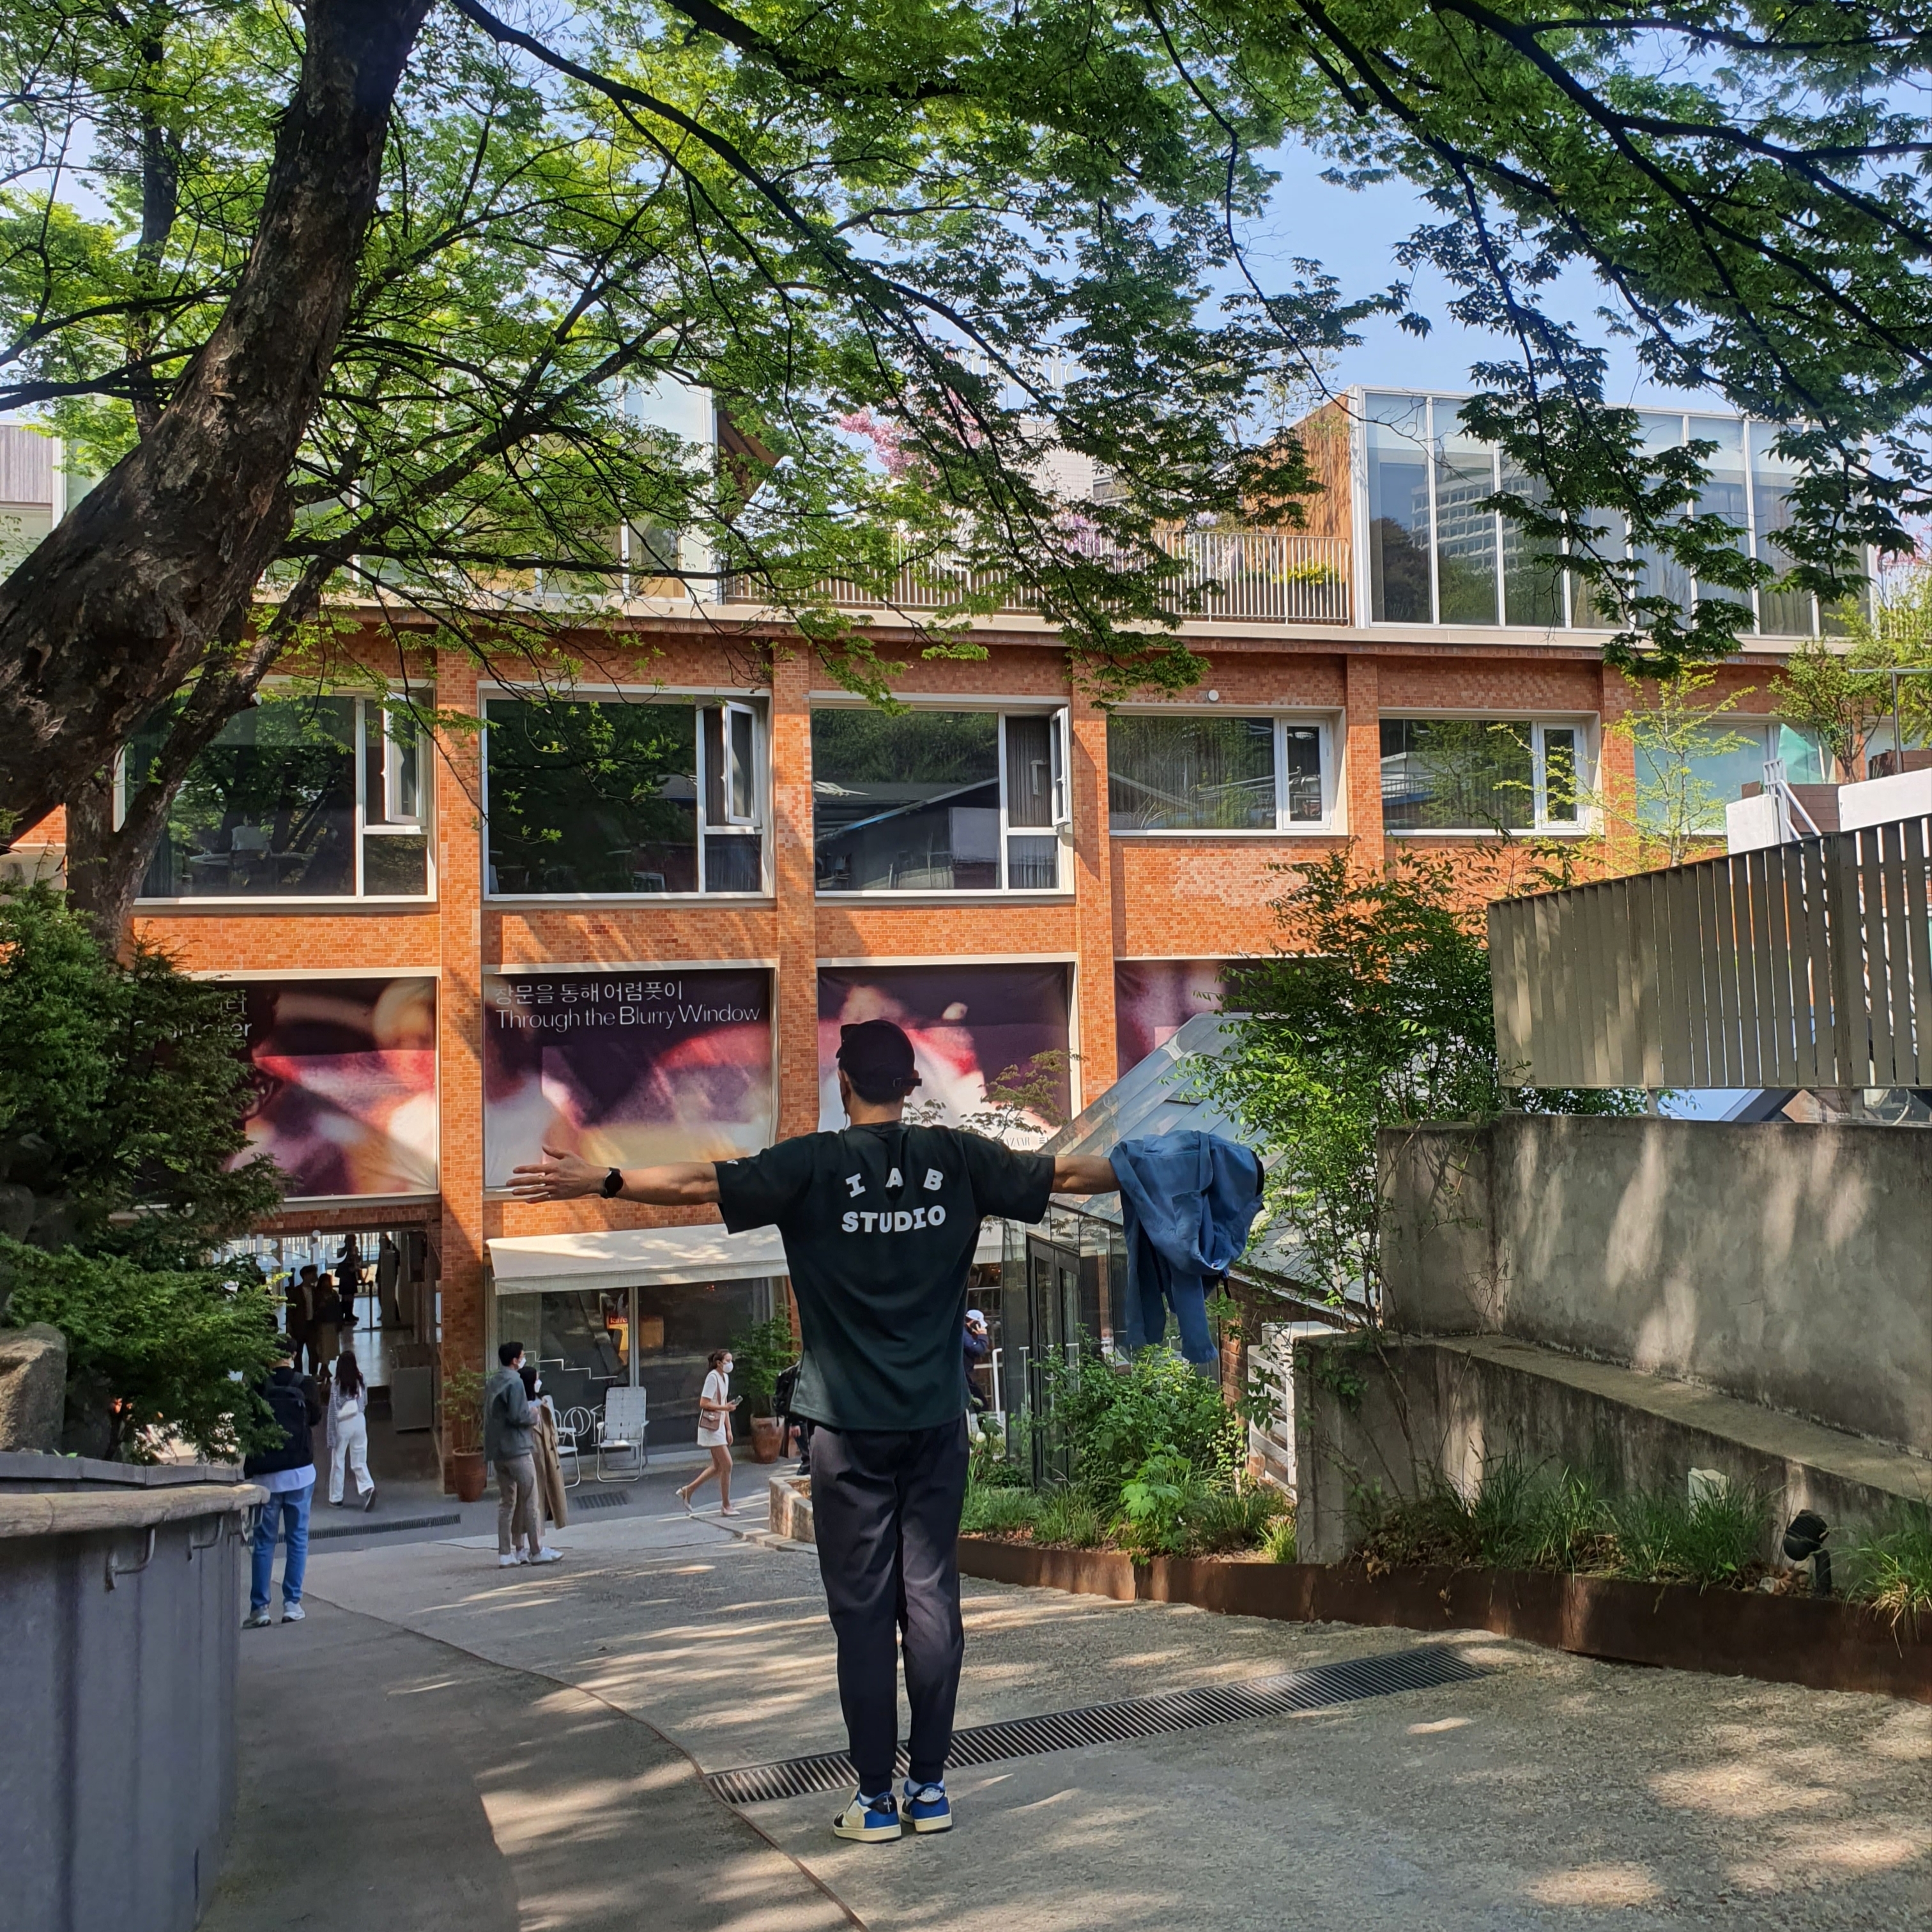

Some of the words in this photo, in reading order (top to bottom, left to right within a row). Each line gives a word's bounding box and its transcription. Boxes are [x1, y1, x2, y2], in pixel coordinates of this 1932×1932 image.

[496, 984, 554, 1006] 창문을
[560, 983, 599, 1004] 통해
[604, 981, 682, 1001] 어렴풋이
[496, 1008, 580, 1033] Through
[585, 1009, 615, 1026] the
[620, 1006, 675, 1029] Blurry
[678, 1002, 760, 1023] Window
[842, 1204, 946, 1233] STUDIO
